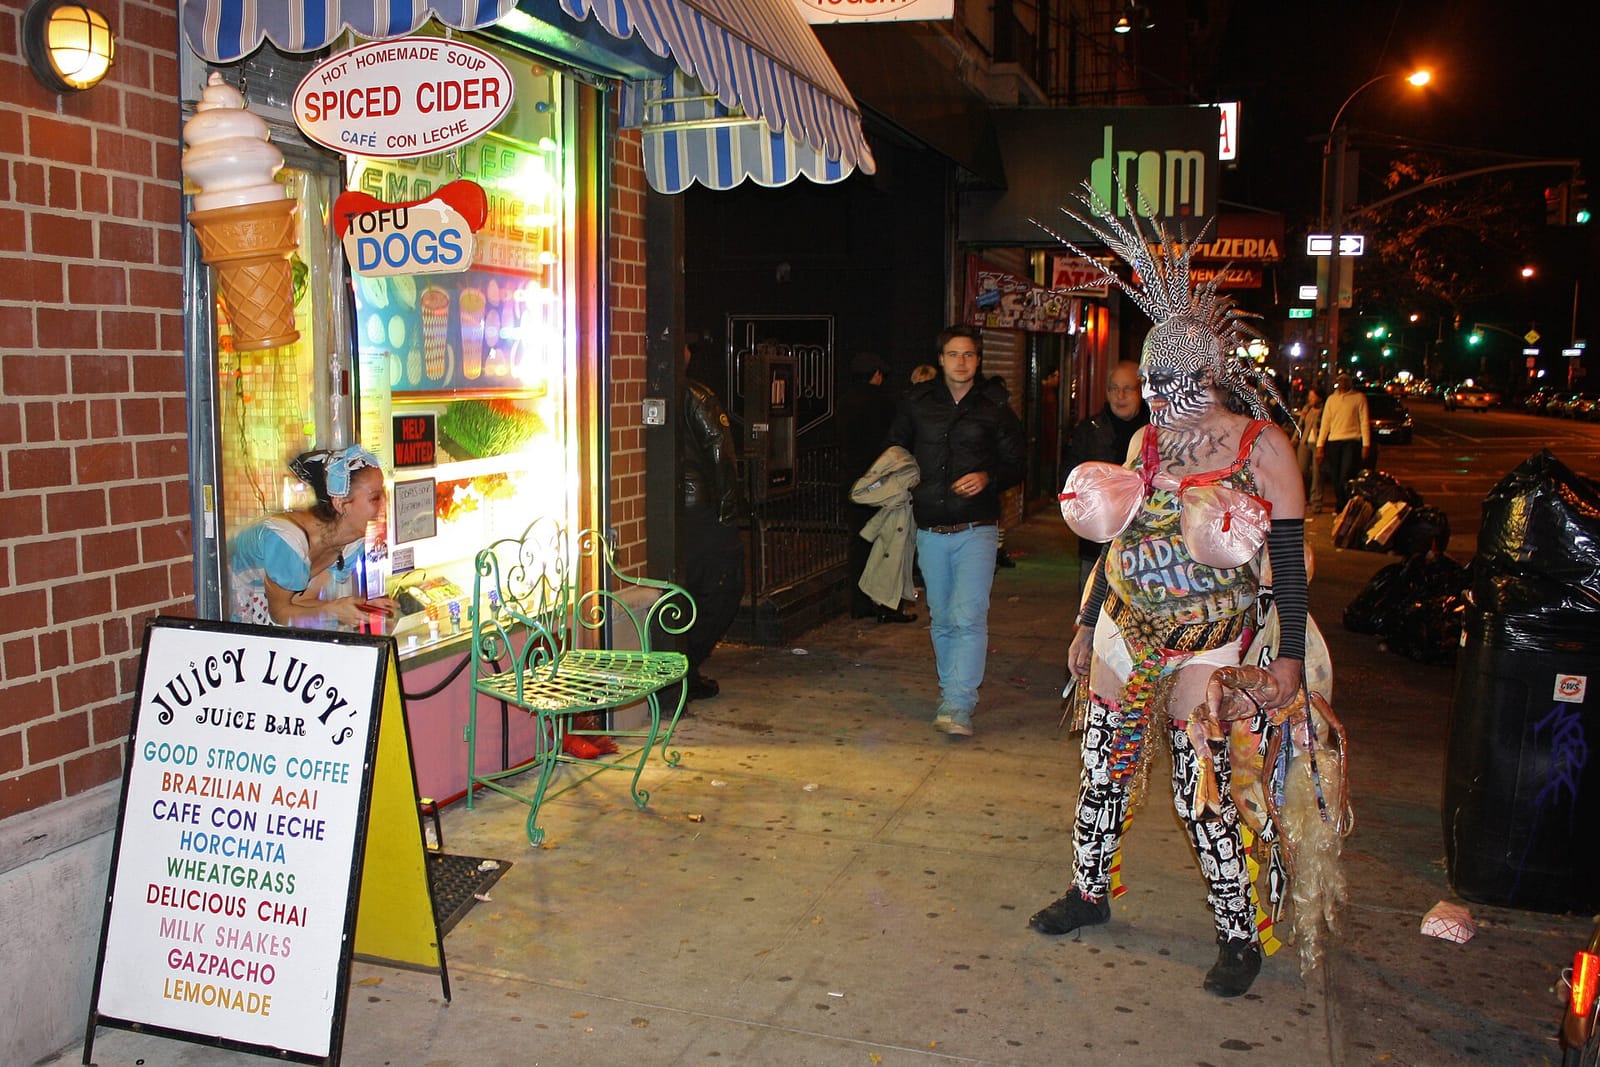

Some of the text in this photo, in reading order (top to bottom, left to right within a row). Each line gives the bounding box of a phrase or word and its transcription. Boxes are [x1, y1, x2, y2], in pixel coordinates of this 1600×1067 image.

[321, 47, 487, 86] HOT HOMEMADE SOUP
[304, 77, 500, 123] SPICED CIDER
[341, 119, 469, 148] CAFÉ CON LECHE
[1090, 125, 1205, 217] drom
[344, 207, 408, 235] TOFU
[357, 228, 463, 271] DOGS
[402, 417, 426, 440] HELP
[395, 441, 433, 464] WANTED
[262, 650, 358, 745] LUCY'S
[1560, 681, 1580, 691] CWS
[195, 707, 307, 737] JUICE BAR
[143, 741, 350, 784] GOOD STRONG COFFEE
[161, 771, 261, 803] BRAZILIAN
[152, 799, 326, 841] CAFE CON LECHE
[180, 830, 286, 864] HORCHATA
[167, 856, 296, 895] WHEATGRASS
[146, 883, 307, 928] DELICIOUS CHAI
[159, 917, 291, 958] MILK SHAKES
[167, 948, 276, 985] GAZPACHO
[163, 977, 272, 1017] LEMONADE
